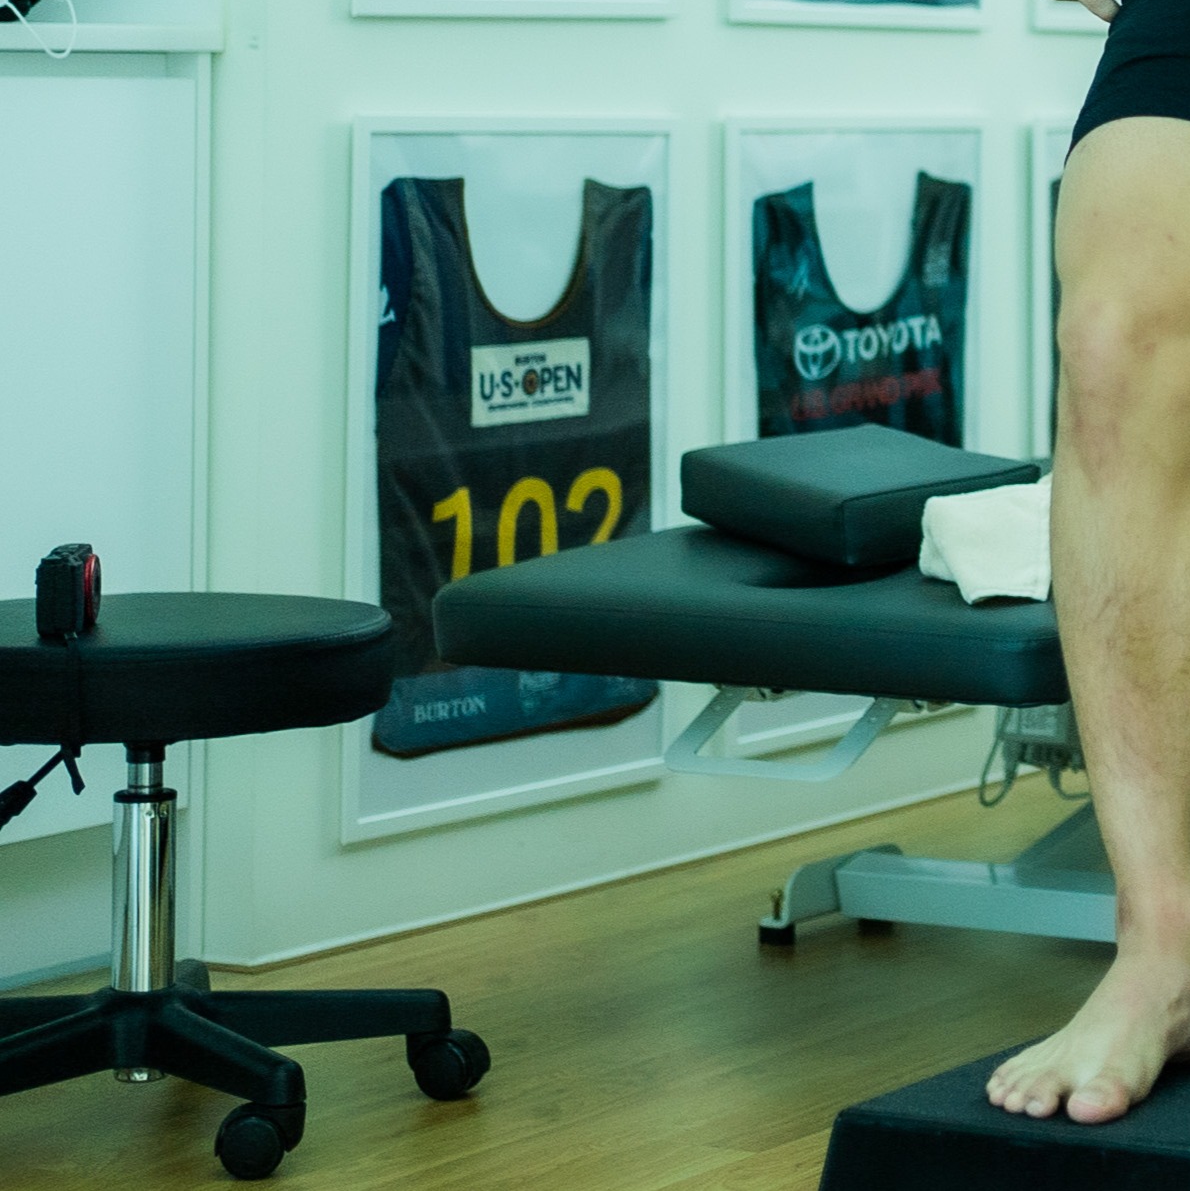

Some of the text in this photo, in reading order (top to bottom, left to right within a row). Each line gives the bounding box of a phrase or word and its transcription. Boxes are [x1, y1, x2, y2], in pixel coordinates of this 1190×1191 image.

[842, 314, 943, 364] TOYOTA
[432, 466, 624, 583] 102
[413, 694, 487, 725] BURTON
